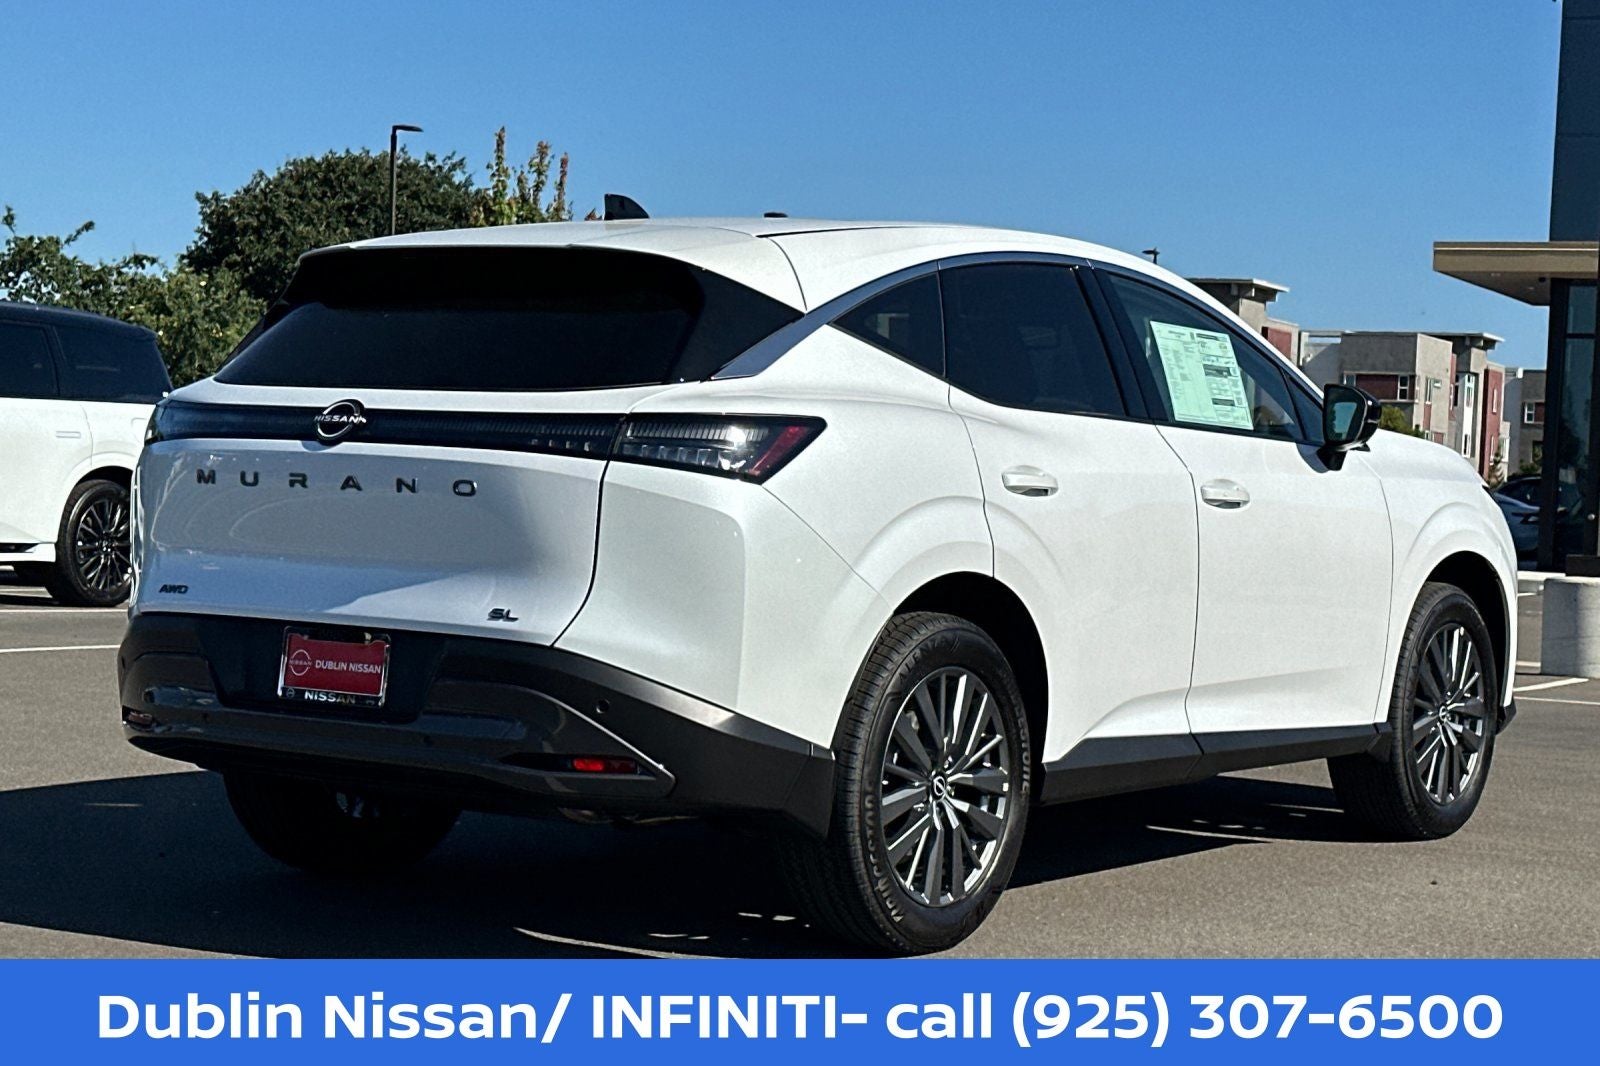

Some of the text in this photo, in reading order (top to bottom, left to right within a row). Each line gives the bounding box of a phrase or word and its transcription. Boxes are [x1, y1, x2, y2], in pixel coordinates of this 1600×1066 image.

[313, 414, 366, 425] NISSAN
[196, 468, 478, 498] MURANO
[158, 583, 189, 595] AWD
[487, 608, 519, 623] SL
[315, 659, 382, 674] DUBLIN NISSAN
[304, 690, 356, 705] NISSAN
